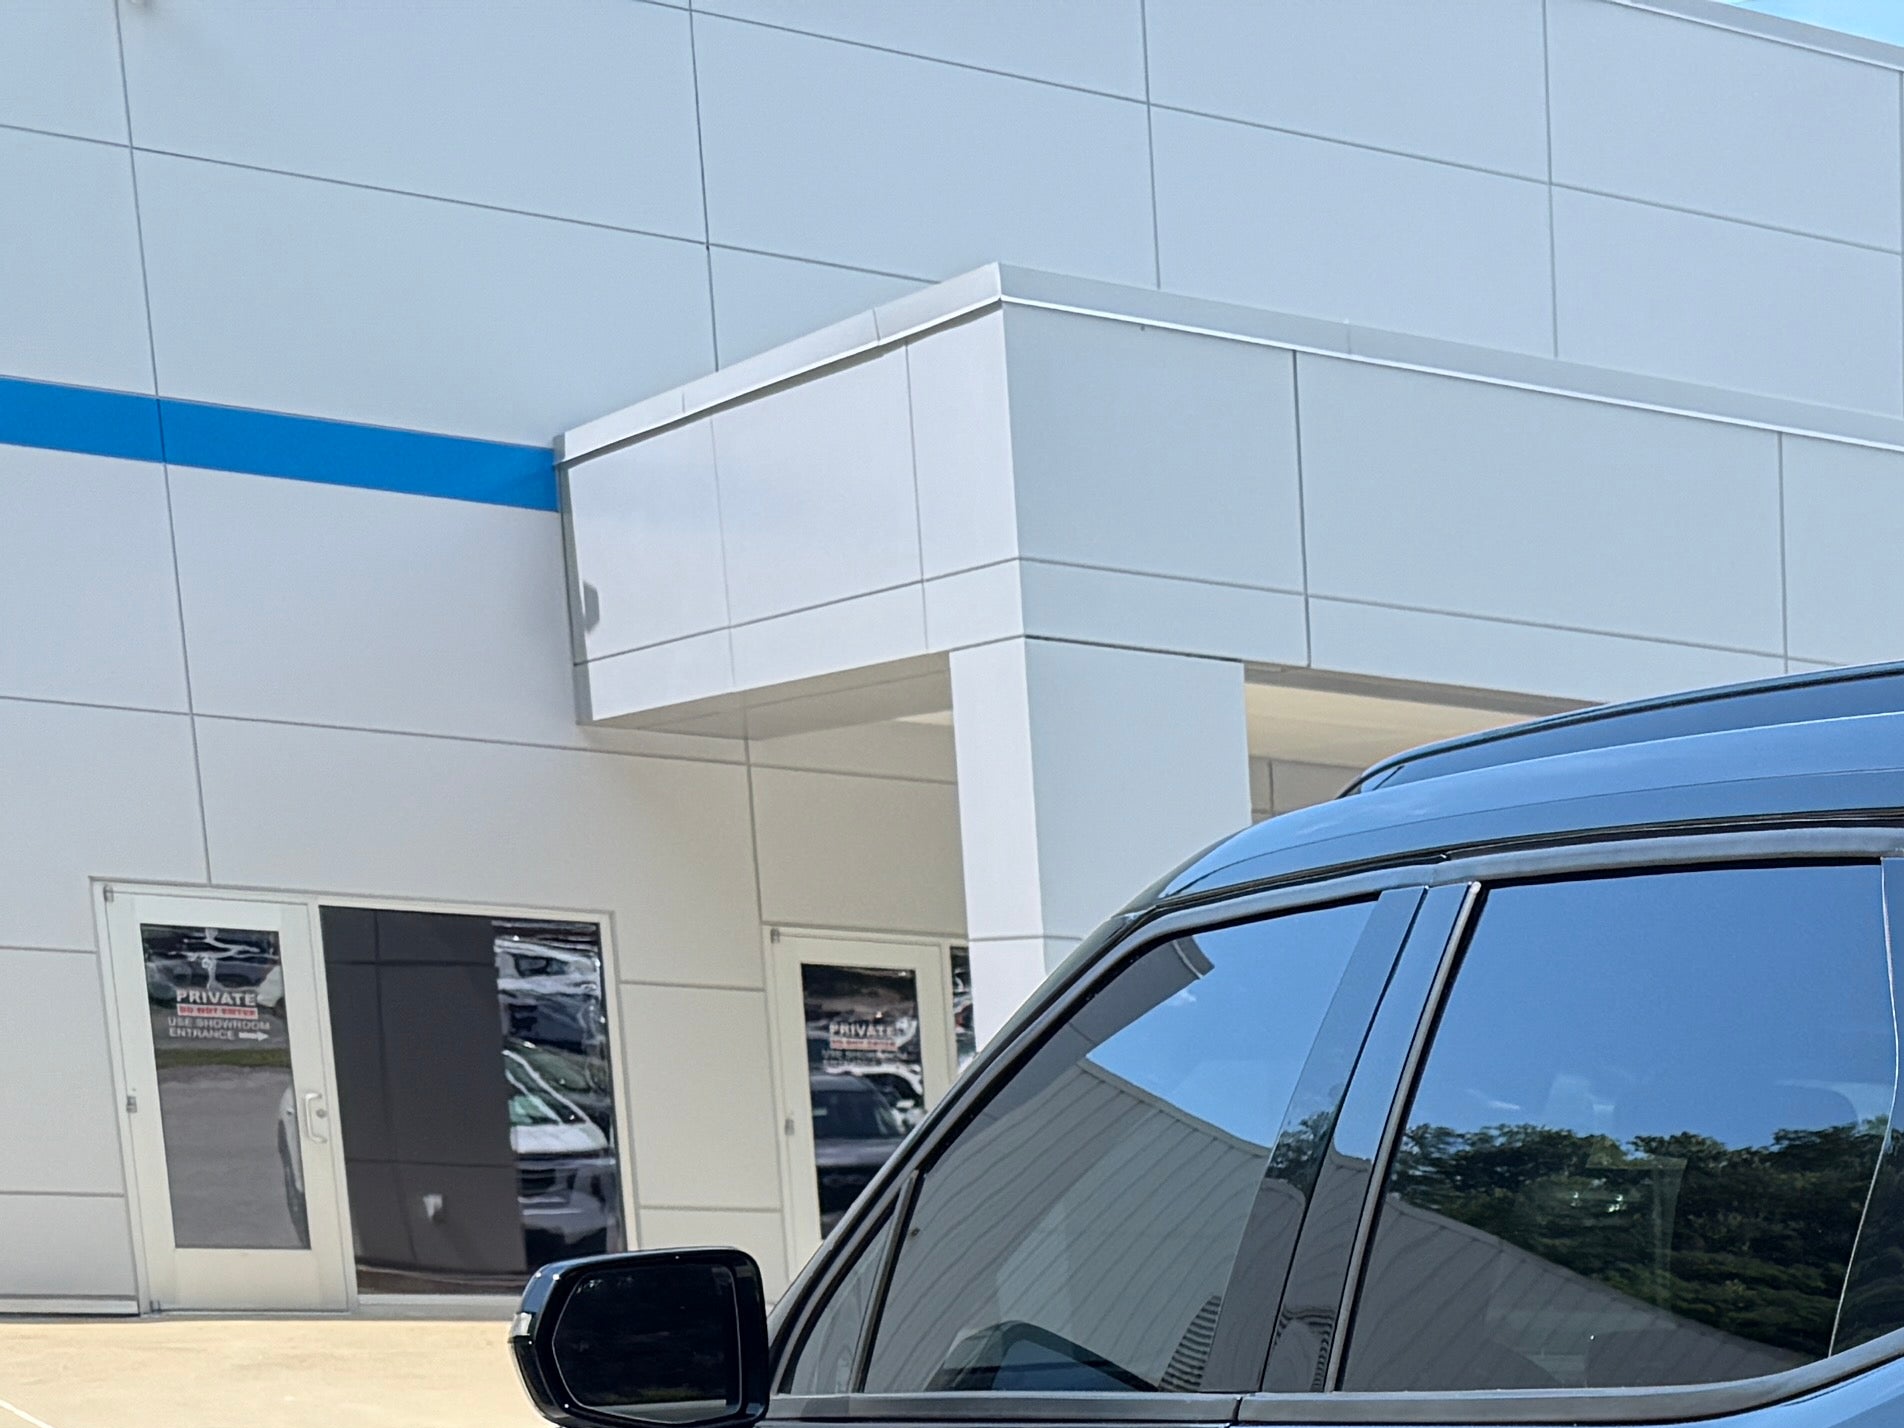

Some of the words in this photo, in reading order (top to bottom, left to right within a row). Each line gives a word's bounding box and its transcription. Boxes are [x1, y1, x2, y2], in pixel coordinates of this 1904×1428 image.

[176, 989, 257, 1006] PRIVATE
[169, 1027, 235, 1040] ENTRANCE
[829, 1020, 895, 1036] PRIVATE
